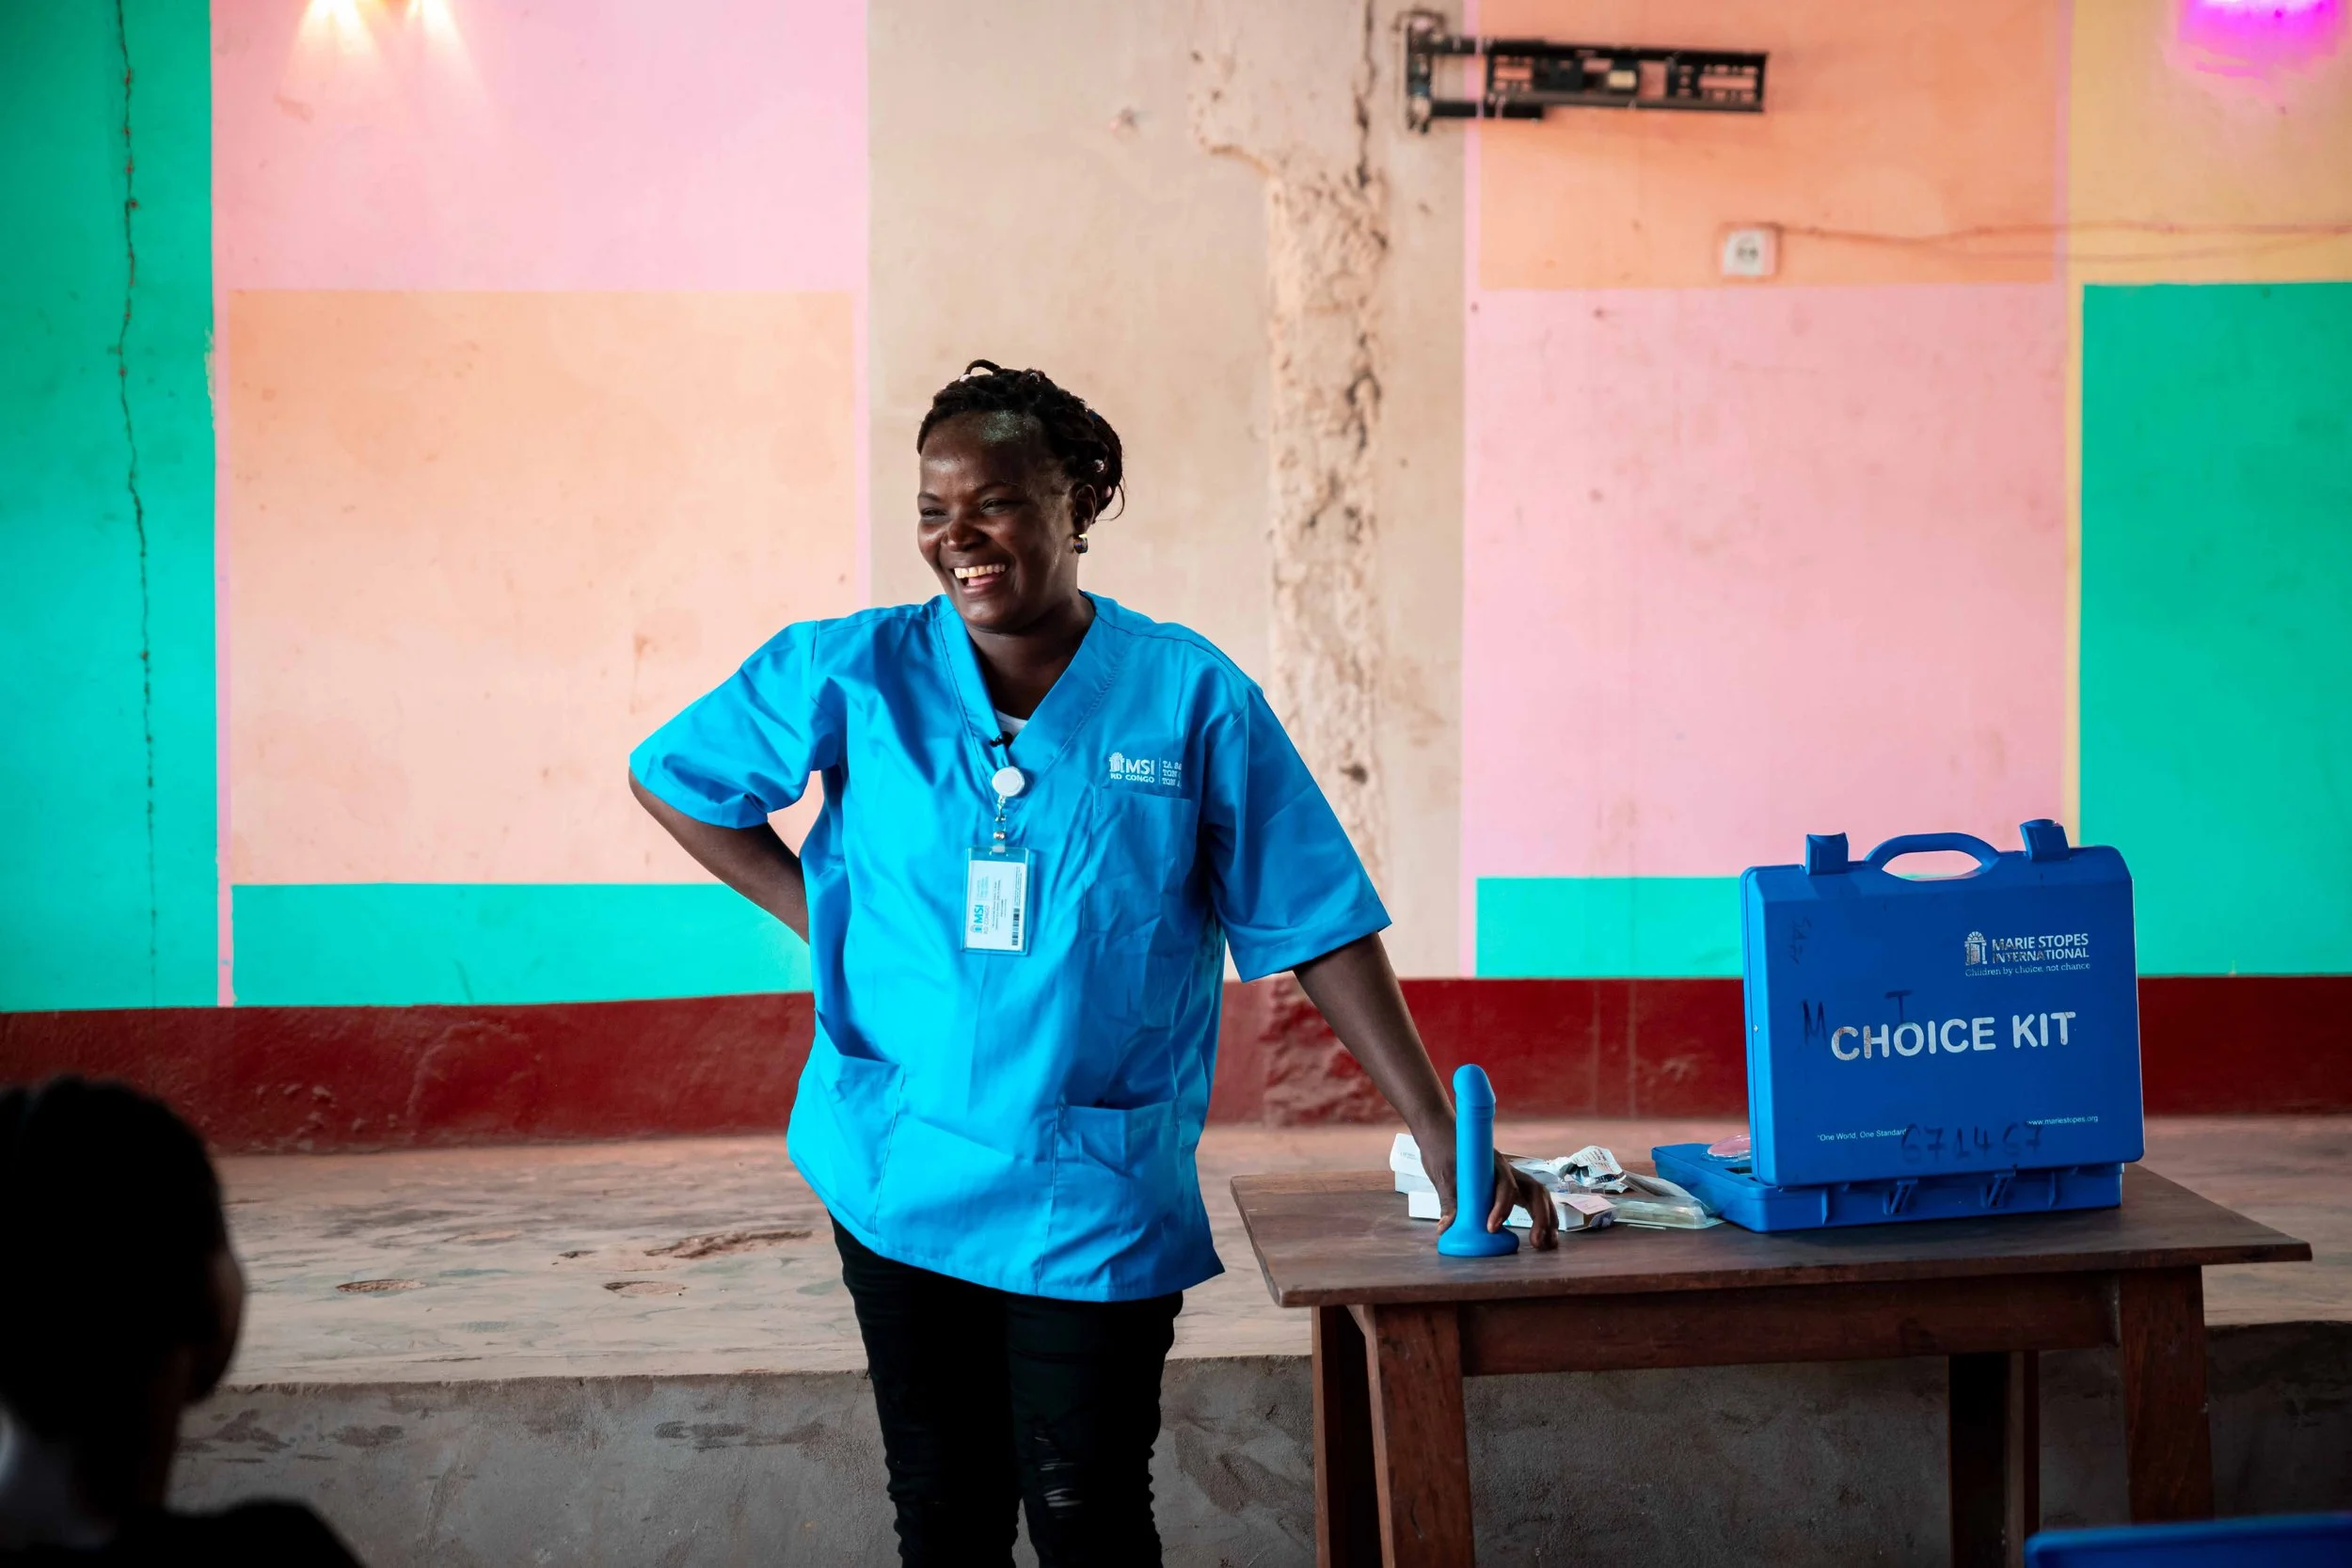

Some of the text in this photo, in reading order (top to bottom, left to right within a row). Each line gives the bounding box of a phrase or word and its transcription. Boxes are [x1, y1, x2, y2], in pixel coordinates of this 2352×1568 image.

[1125, 759, 1155, 775] MSI
[1173, 762, 1183, 770] SA
[1125, 772, 1155, 784] CONGO
[974, 904, 984, 924] MSI
[1992, 933, 2090, 951] MARIE STOPES
[1992, 947, 2090, 964] INTERNATIONAL
[1965, 967, 2001, 977] Children
[2002, 966, 2013, 976] by
[2045, 964, 2059, 973] not
[2060, 962, 2091, 972] chance
[1830, 1011, 2077, 1061] CHOICE KIT
[1836, 1132, 1858, 1141] World,
